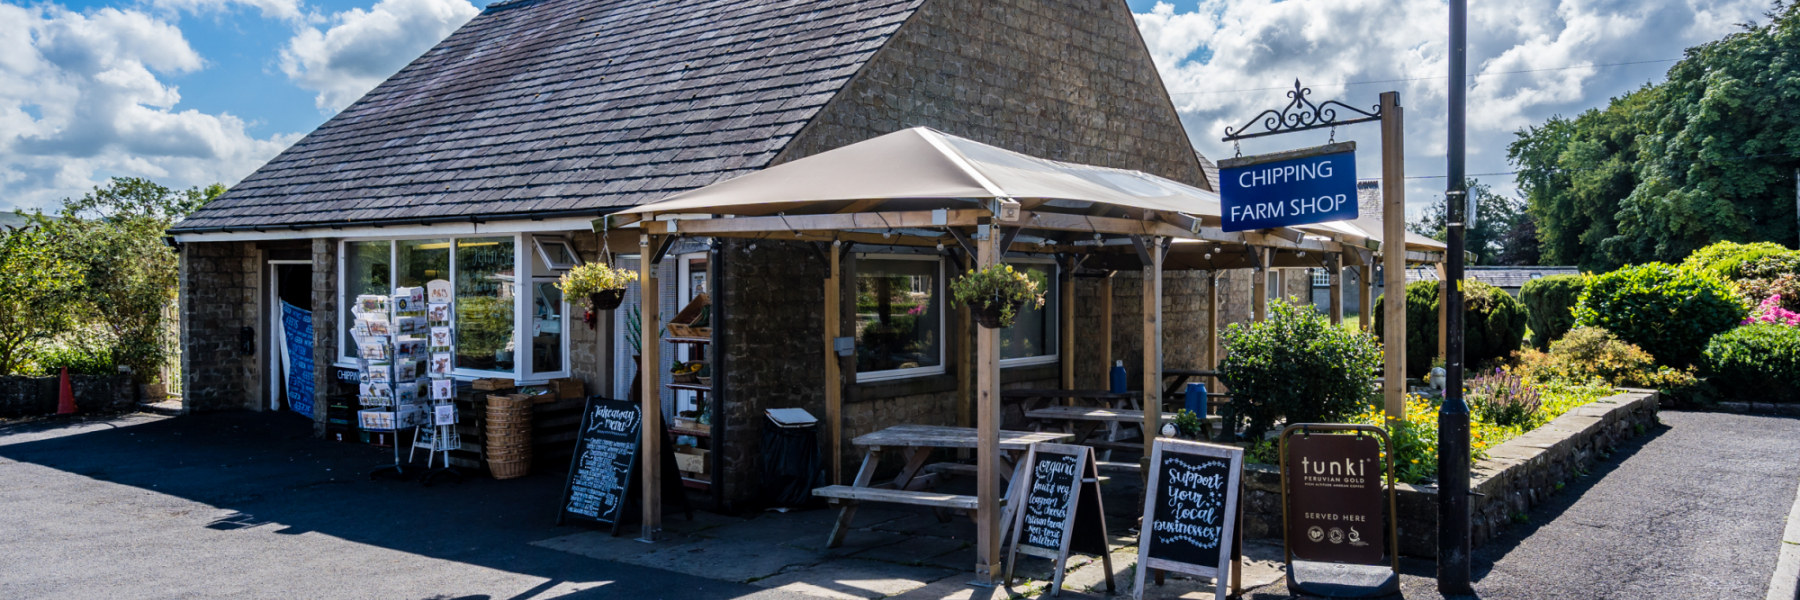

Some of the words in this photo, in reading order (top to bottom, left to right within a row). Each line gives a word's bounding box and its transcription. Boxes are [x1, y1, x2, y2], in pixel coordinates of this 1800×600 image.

[1239, 161, 1333, 188] CHIPPING
[1231, 201, 1285, 222] FARM
[1290, 194, 1347, 216] SHOP
[337, 369, 360, 382] CHIPPIN
[594, 405, 635, 428] Takeaway
[604, 419, 626, 432] menu
[1301, 456, 1364, 476] tunki
[1169, 468, 1223, 490] Support
[1033, 479, 1050, 493] fruit
[1056, 485, 1071, 502] veg
[1304, 512, 1339, 521] SERVED
[1342, 514, 1366, 522] HERE
